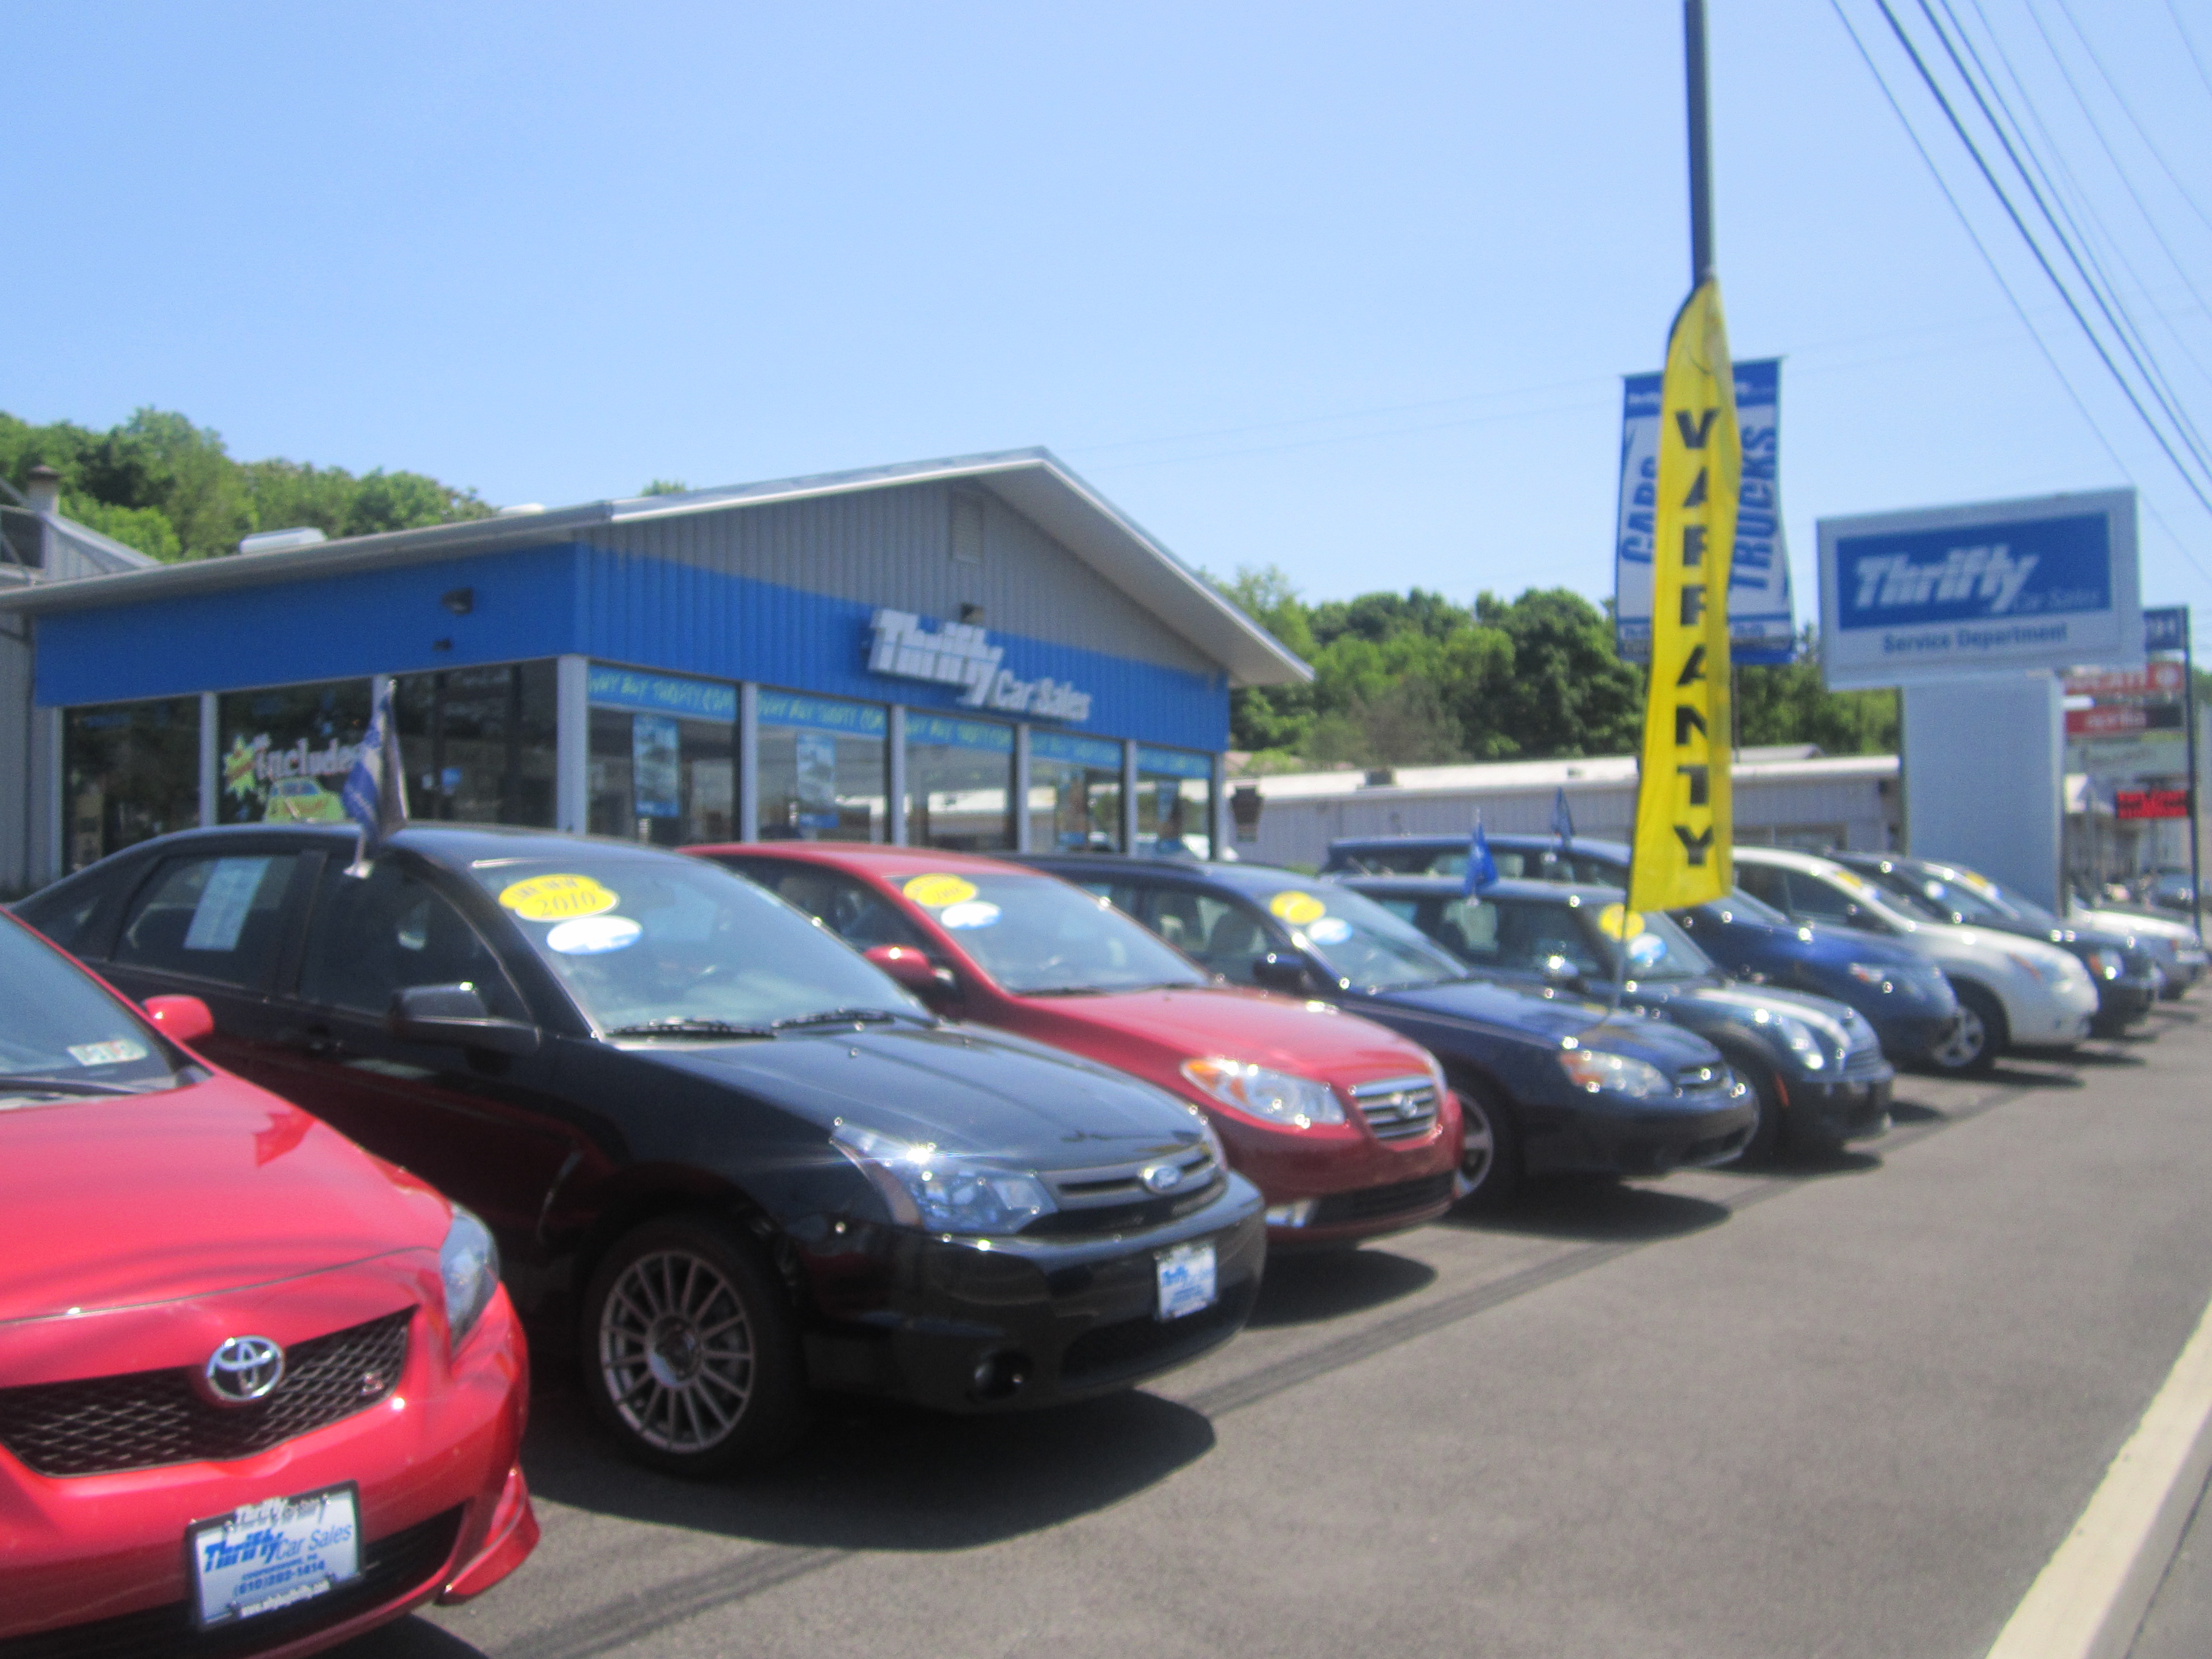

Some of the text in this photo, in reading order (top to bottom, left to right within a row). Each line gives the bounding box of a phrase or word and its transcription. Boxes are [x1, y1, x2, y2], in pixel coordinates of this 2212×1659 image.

[1855, 543, 2038, 612] Thrifty
[1882, 622, 2067, 654] Service Department
[868, 608, 1091, 721] Thrifty Car Sales
[537, 891, 596, 917] 2010
[204, 1528, 285, 1573] Thrifty
[275, 1534, 304, 1560] Car
[308, 1523, 352, 1550] Sales
